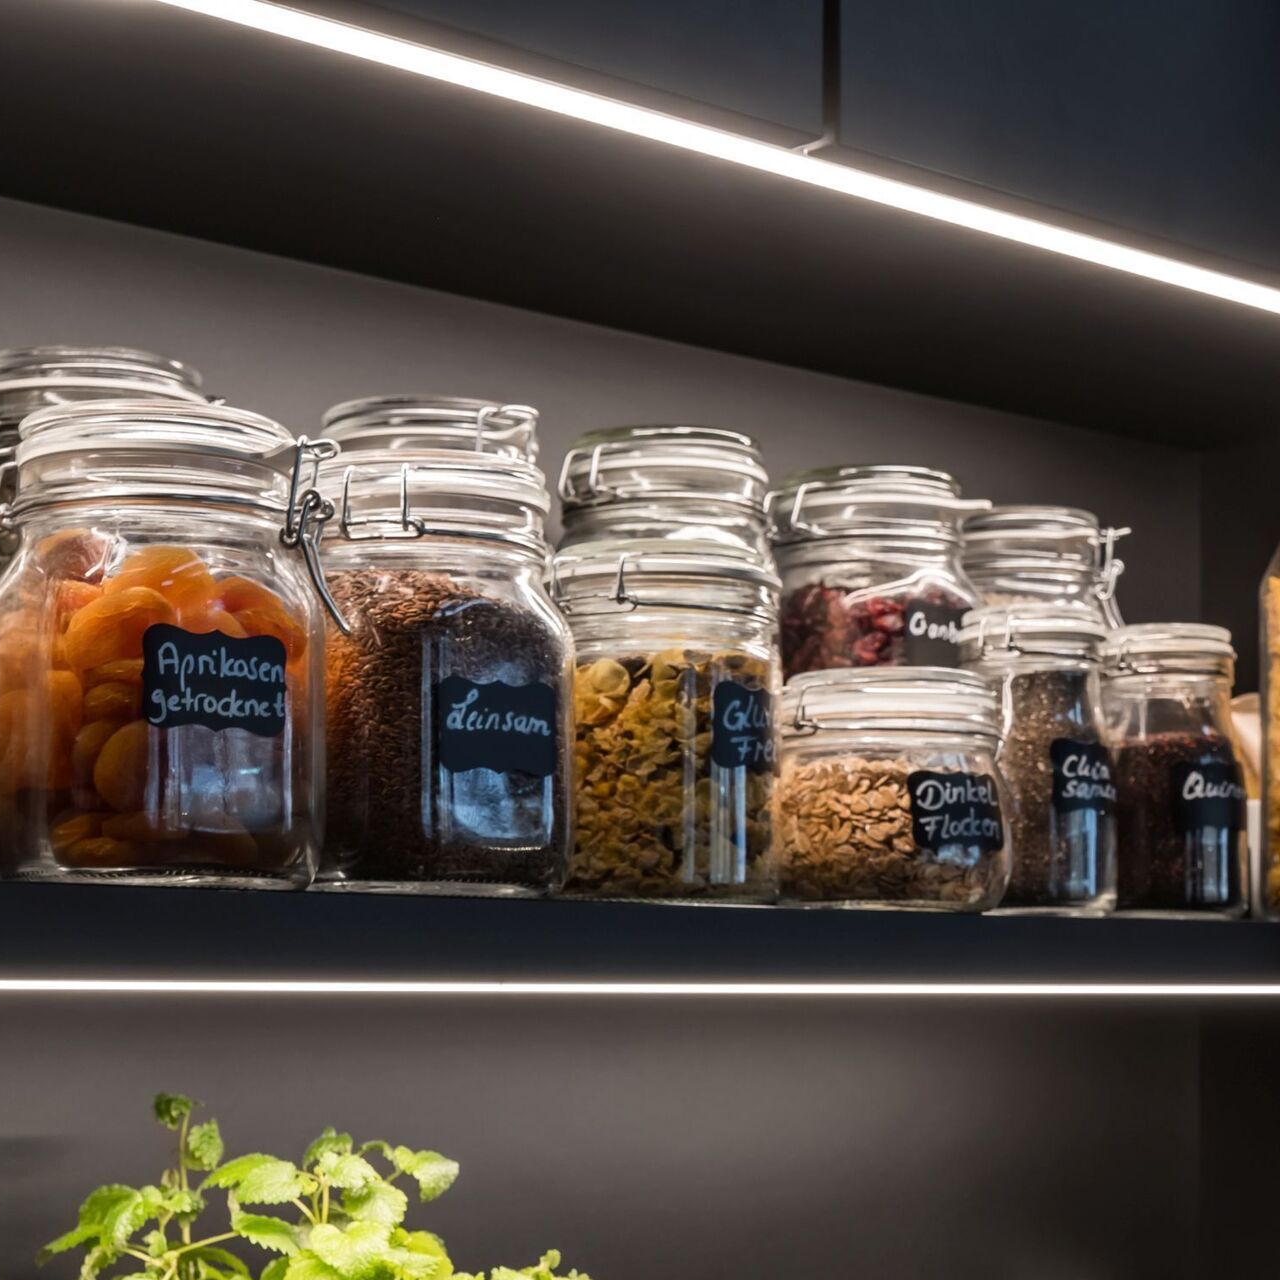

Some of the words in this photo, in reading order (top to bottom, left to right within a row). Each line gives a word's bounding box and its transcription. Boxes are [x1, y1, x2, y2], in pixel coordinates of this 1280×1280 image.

[157, 641, 284, 692] Aprikosen
[149, 687, 284, 724] getrocknet
[915, 779, 998, 811] Dinkel
[919, 807, 1000, 841] Flocken
